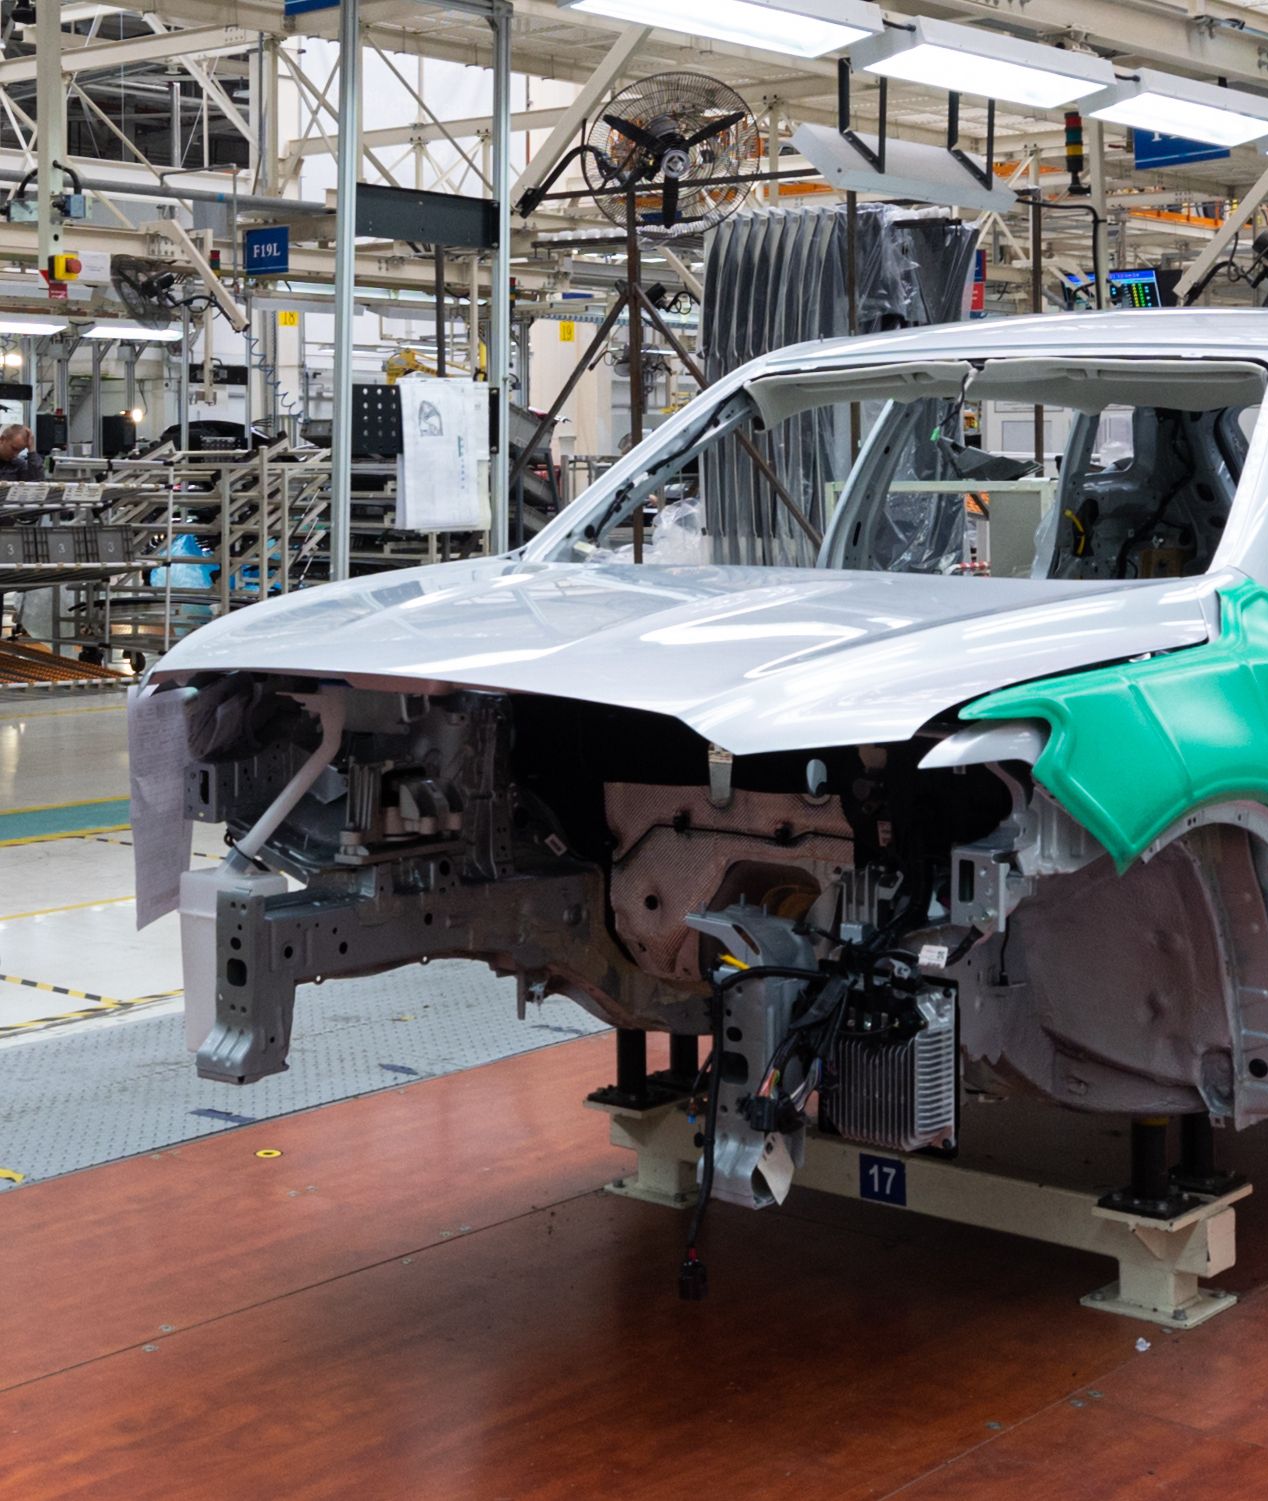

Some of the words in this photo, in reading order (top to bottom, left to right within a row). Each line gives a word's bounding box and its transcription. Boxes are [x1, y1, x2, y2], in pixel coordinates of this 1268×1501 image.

[253, 243, 281, 258] F19L
[7, 544, 15, 556] 3
[58, 543, 66, 554] 3
[868, 1164, 897, 1195] 17
